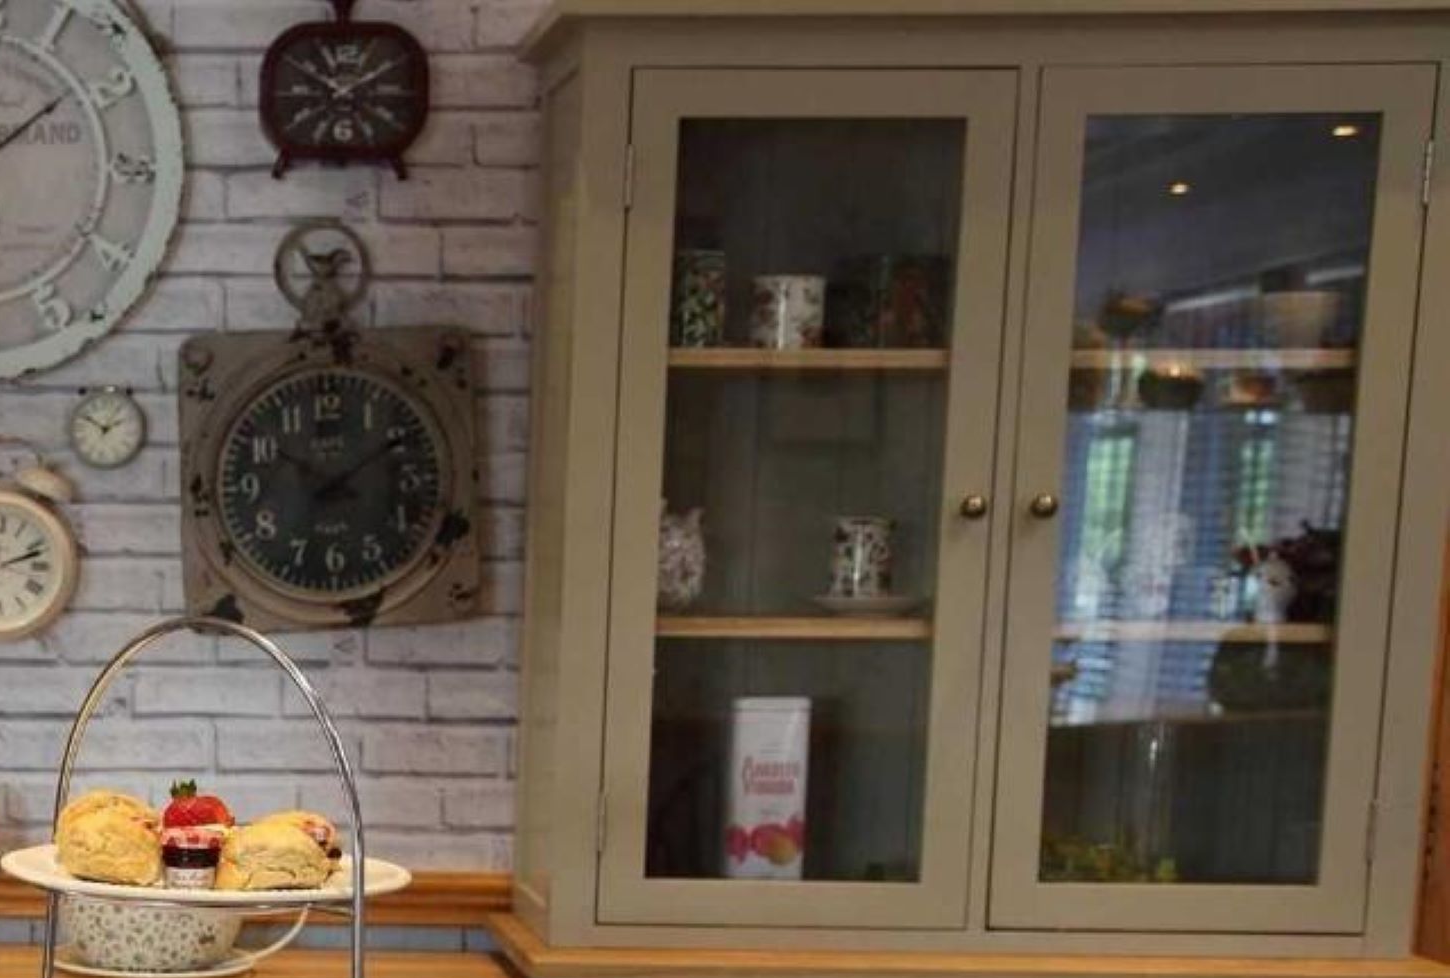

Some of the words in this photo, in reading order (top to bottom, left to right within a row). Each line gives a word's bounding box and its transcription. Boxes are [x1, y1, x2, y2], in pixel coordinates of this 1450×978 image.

[333, 119, 354, 141] 6
[282, 404, 302, 434] 11
[314, 395, 342, 422] 12
[364, 400, 373, 430] 1
[252, 436, 278, 465] 10
[240, 472, 261, 505] 9
[400, 463, 422, 493] 3
[255, 510, 277, 541] 8
[289, 538, 309, 566] 7
[325, 542, 346, 573] 6
[362, 534, 383, 562] 5
